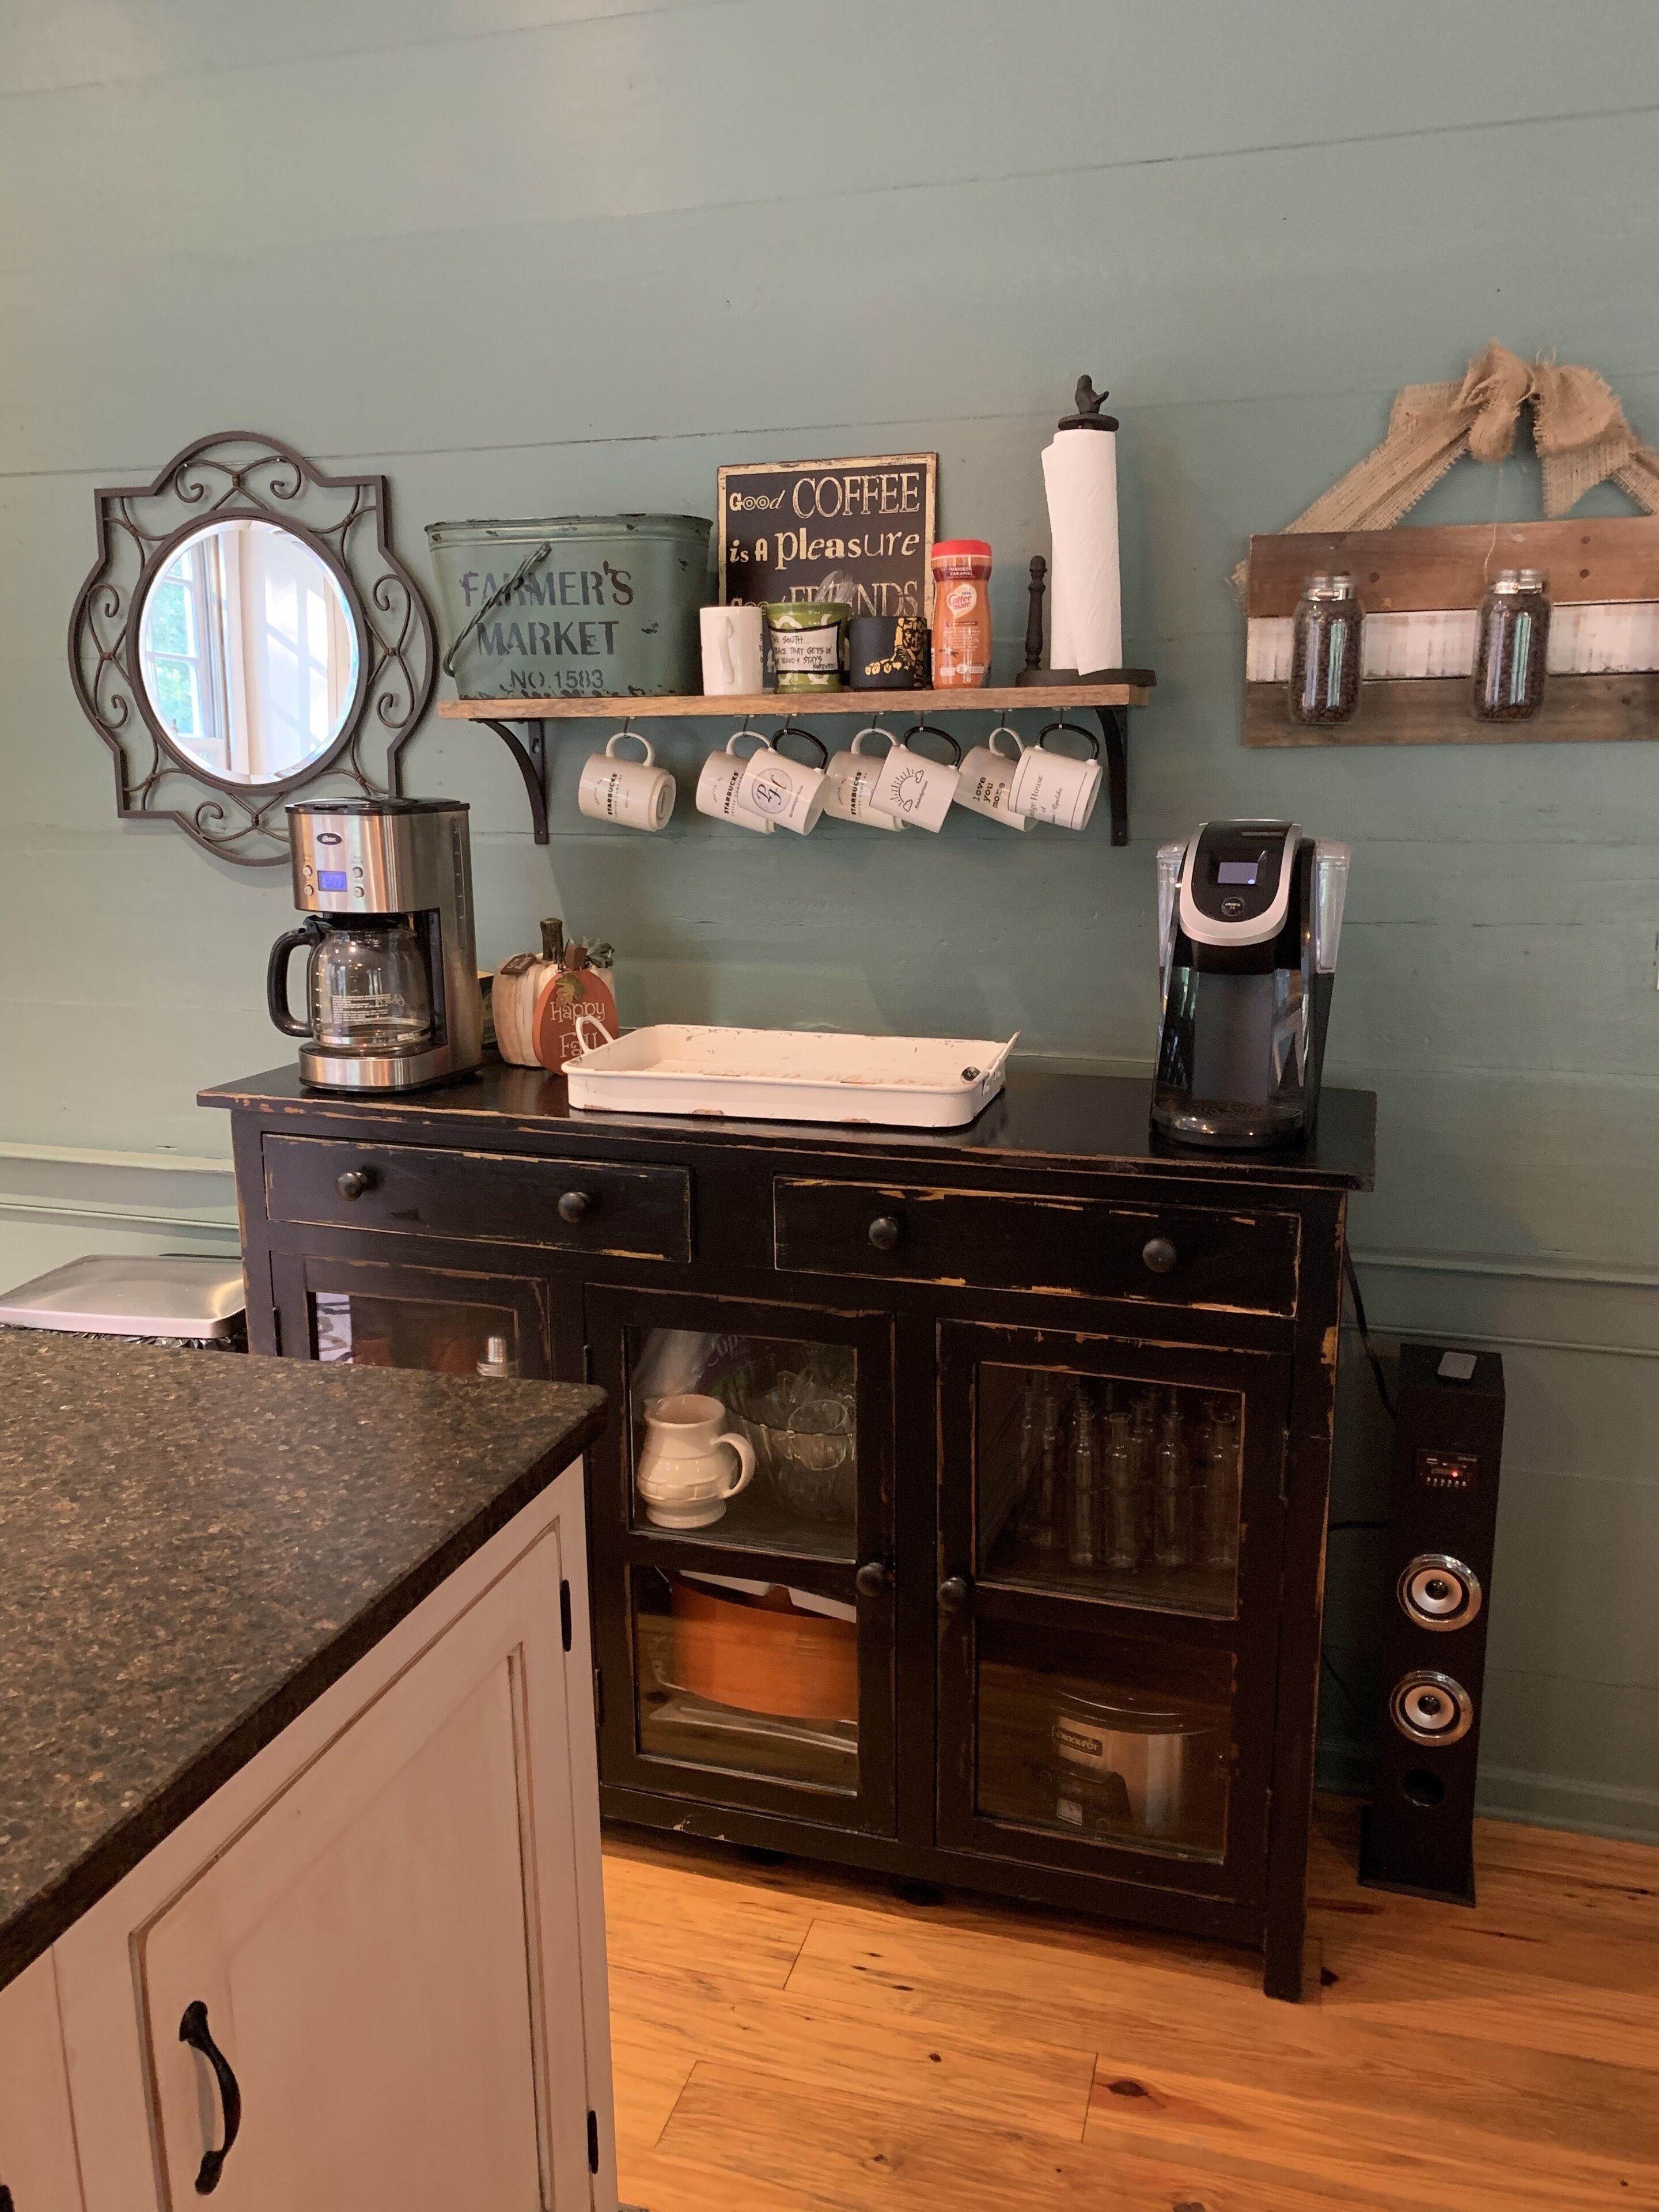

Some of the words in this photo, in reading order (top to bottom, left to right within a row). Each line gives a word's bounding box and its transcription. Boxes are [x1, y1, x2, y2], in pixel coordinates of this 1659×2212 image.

[729, 490, 786, 512] Good
[792, 472, 921, 518] COFFEE
[729, 540, 749, 563] is
[755, 538, 768, 562] A
[948, 594, 972, 606] Coffee
[953, 601, 971, 610] mate
[476, 620, 619, 656] MARKET
[790, 647, 805, 656] THAT
[806, 646, 824, 655] GETS
[802, 655, 823, 665] STAYS
[608, 772, 618, 816] STARBUCKS
[724, 772, 739, 815] STARBUCKS
[851, 771, 862, 816] STARBUCKS
[972, 777, 986, 802] love
[983, 782, 994, 803] you
[993, 782, 1005, 809] more
[1031, 775, 1043, 801] House
[550, 1001, 605, 1025] Happy
[559, 1032, 598, 1058] Fall
